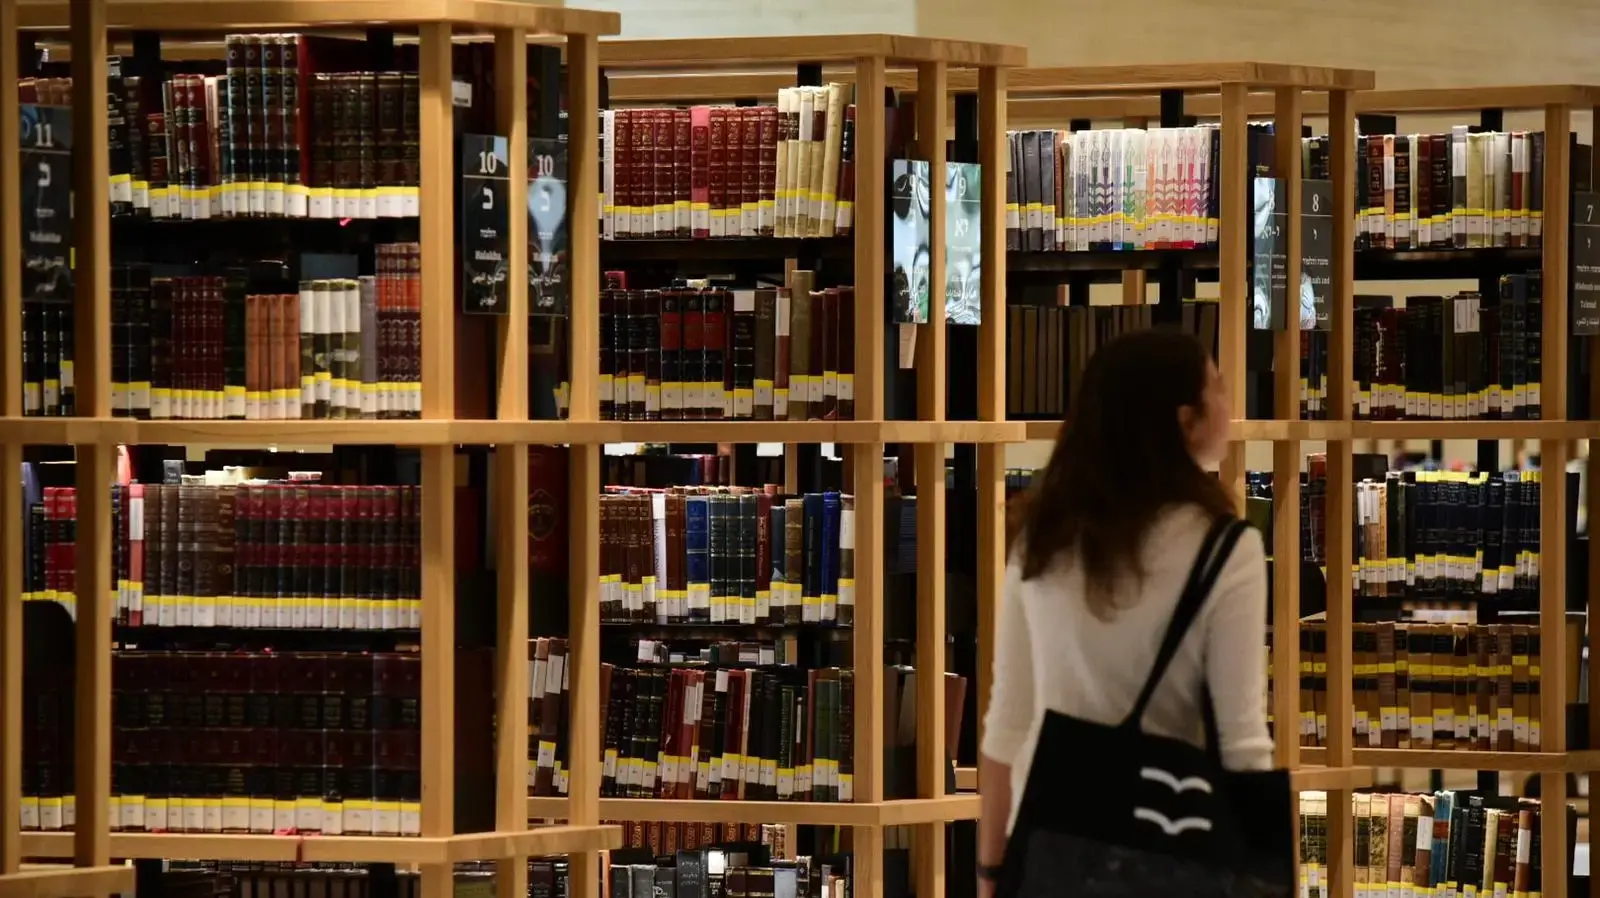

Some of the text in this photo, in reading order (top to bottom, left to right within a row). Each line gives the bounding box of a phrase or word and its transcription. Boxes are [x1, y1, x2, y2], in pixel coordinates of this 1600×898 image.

[35, 123, 53, 147] 11
[479, 151, 497, 173] 10
[536, 155, 554, 176] 10
[958, 176, 967, 197] 9
[1312, 193, 1320, 213] 8
[1587, 204, 1594, 223] 7
